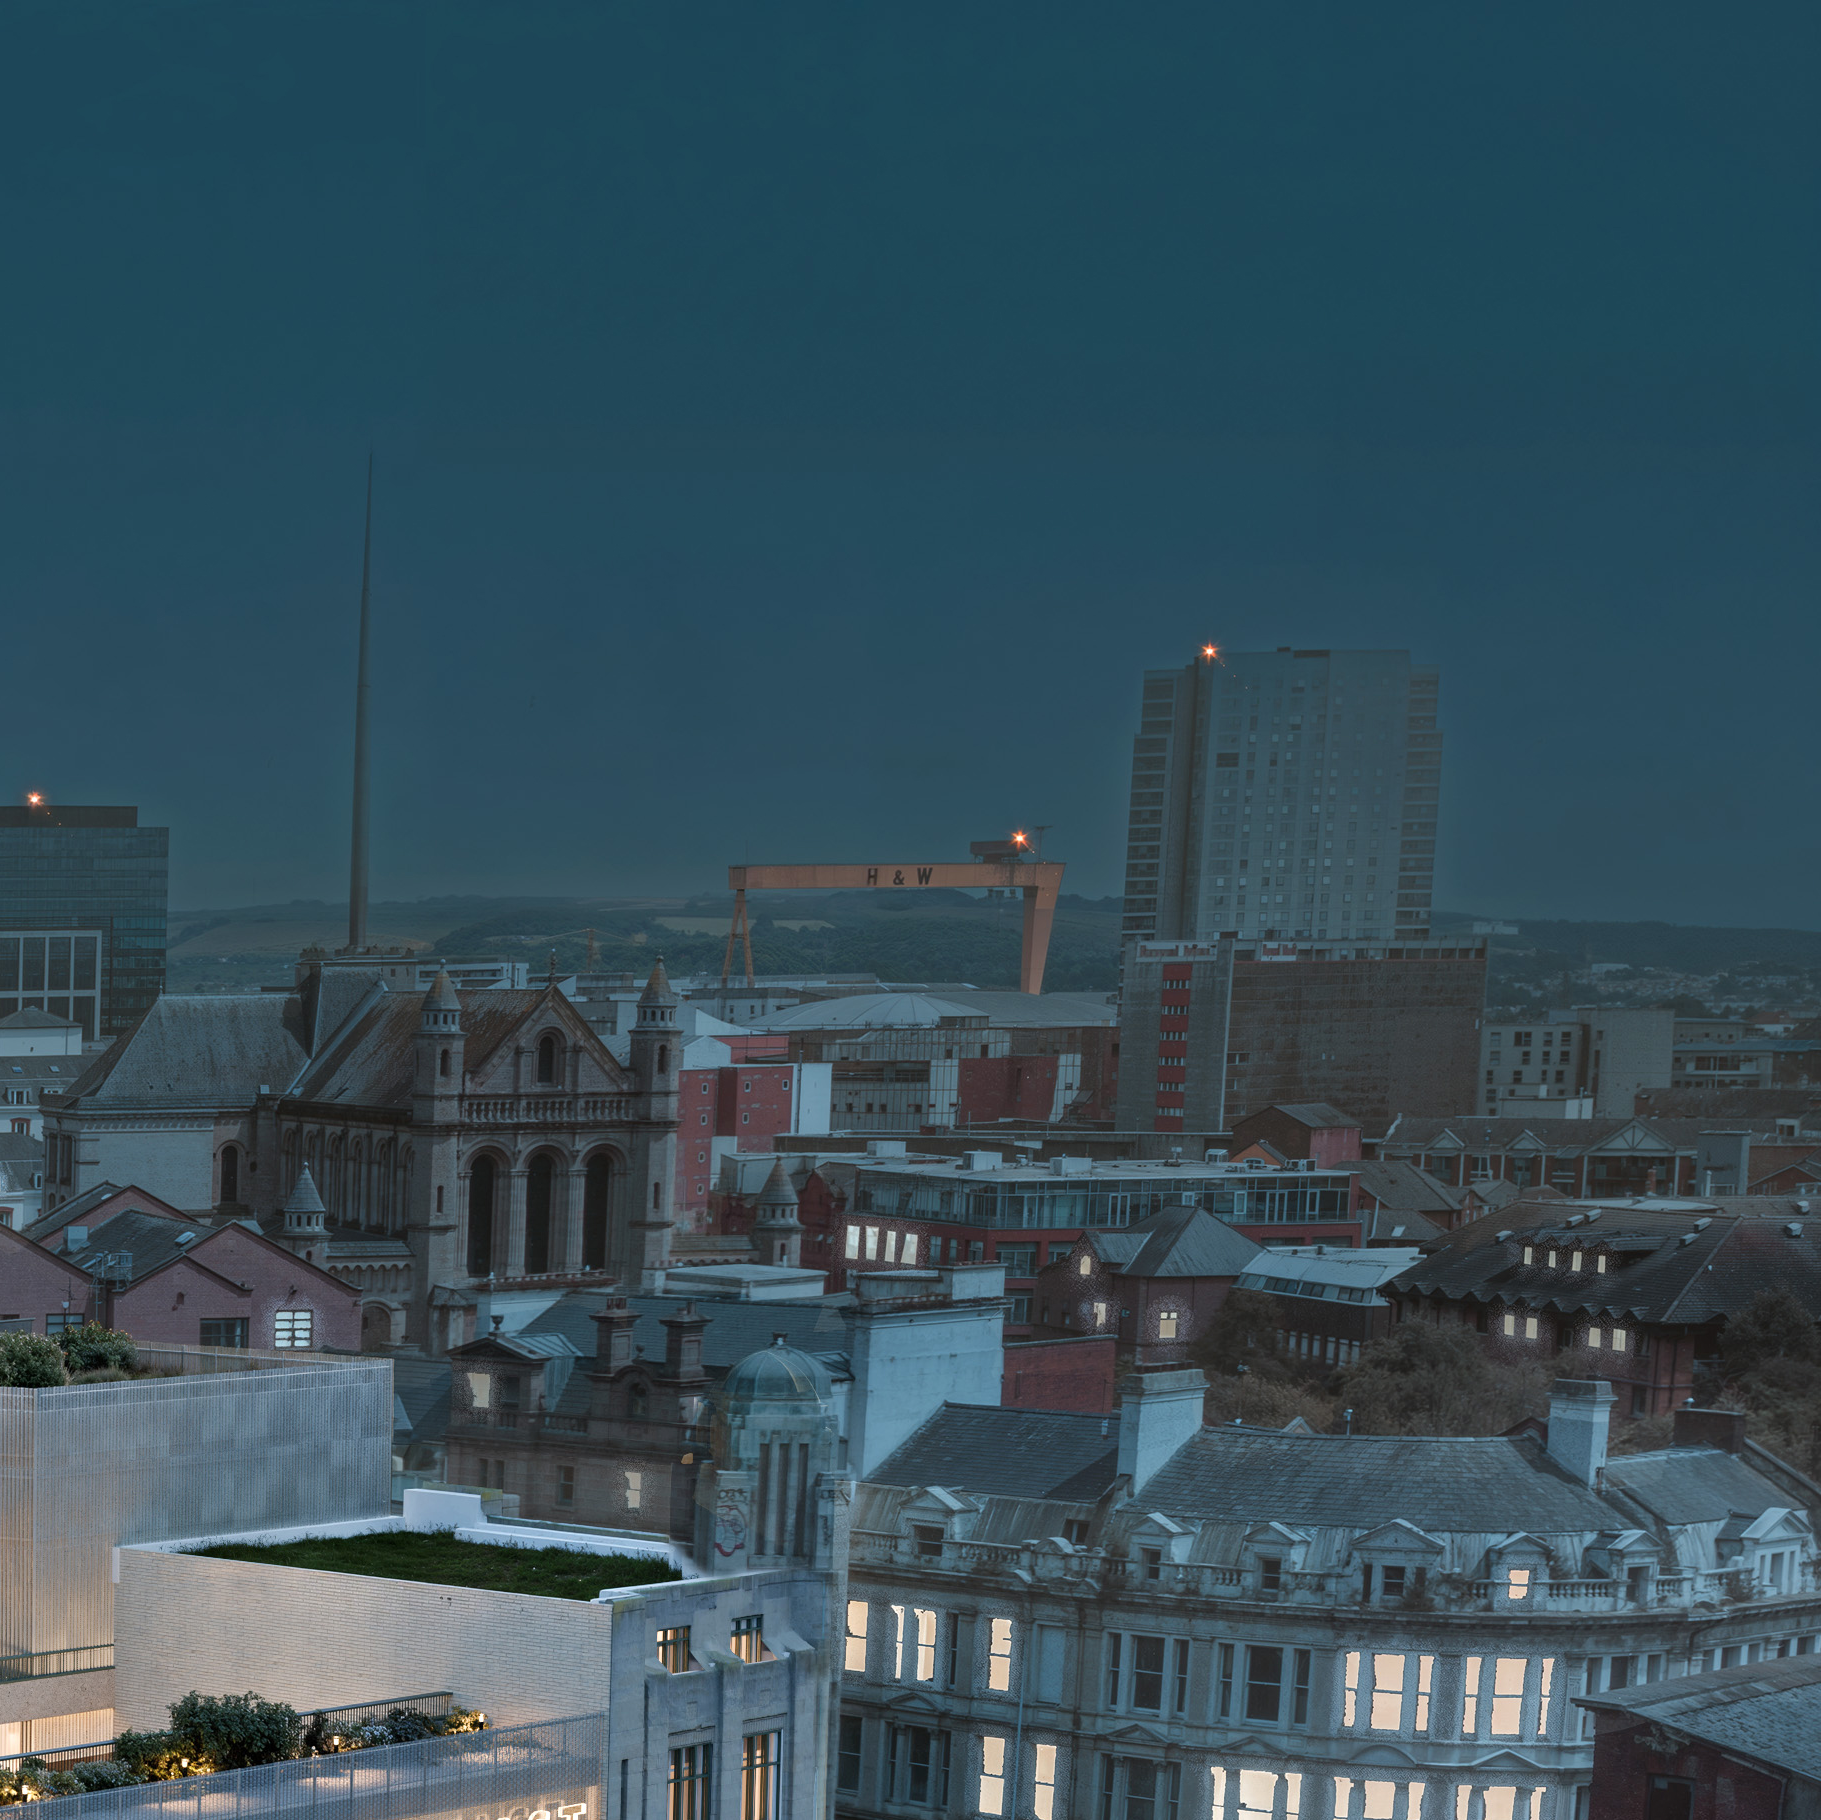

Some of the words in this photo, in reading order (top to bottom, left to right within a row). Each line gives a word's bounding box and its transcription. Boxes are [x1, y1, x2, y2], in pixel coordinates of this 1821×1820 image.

[867, 867, 878, 886] H
[893, 869, 905, 886] &
[917, 867, 933, 886] W
